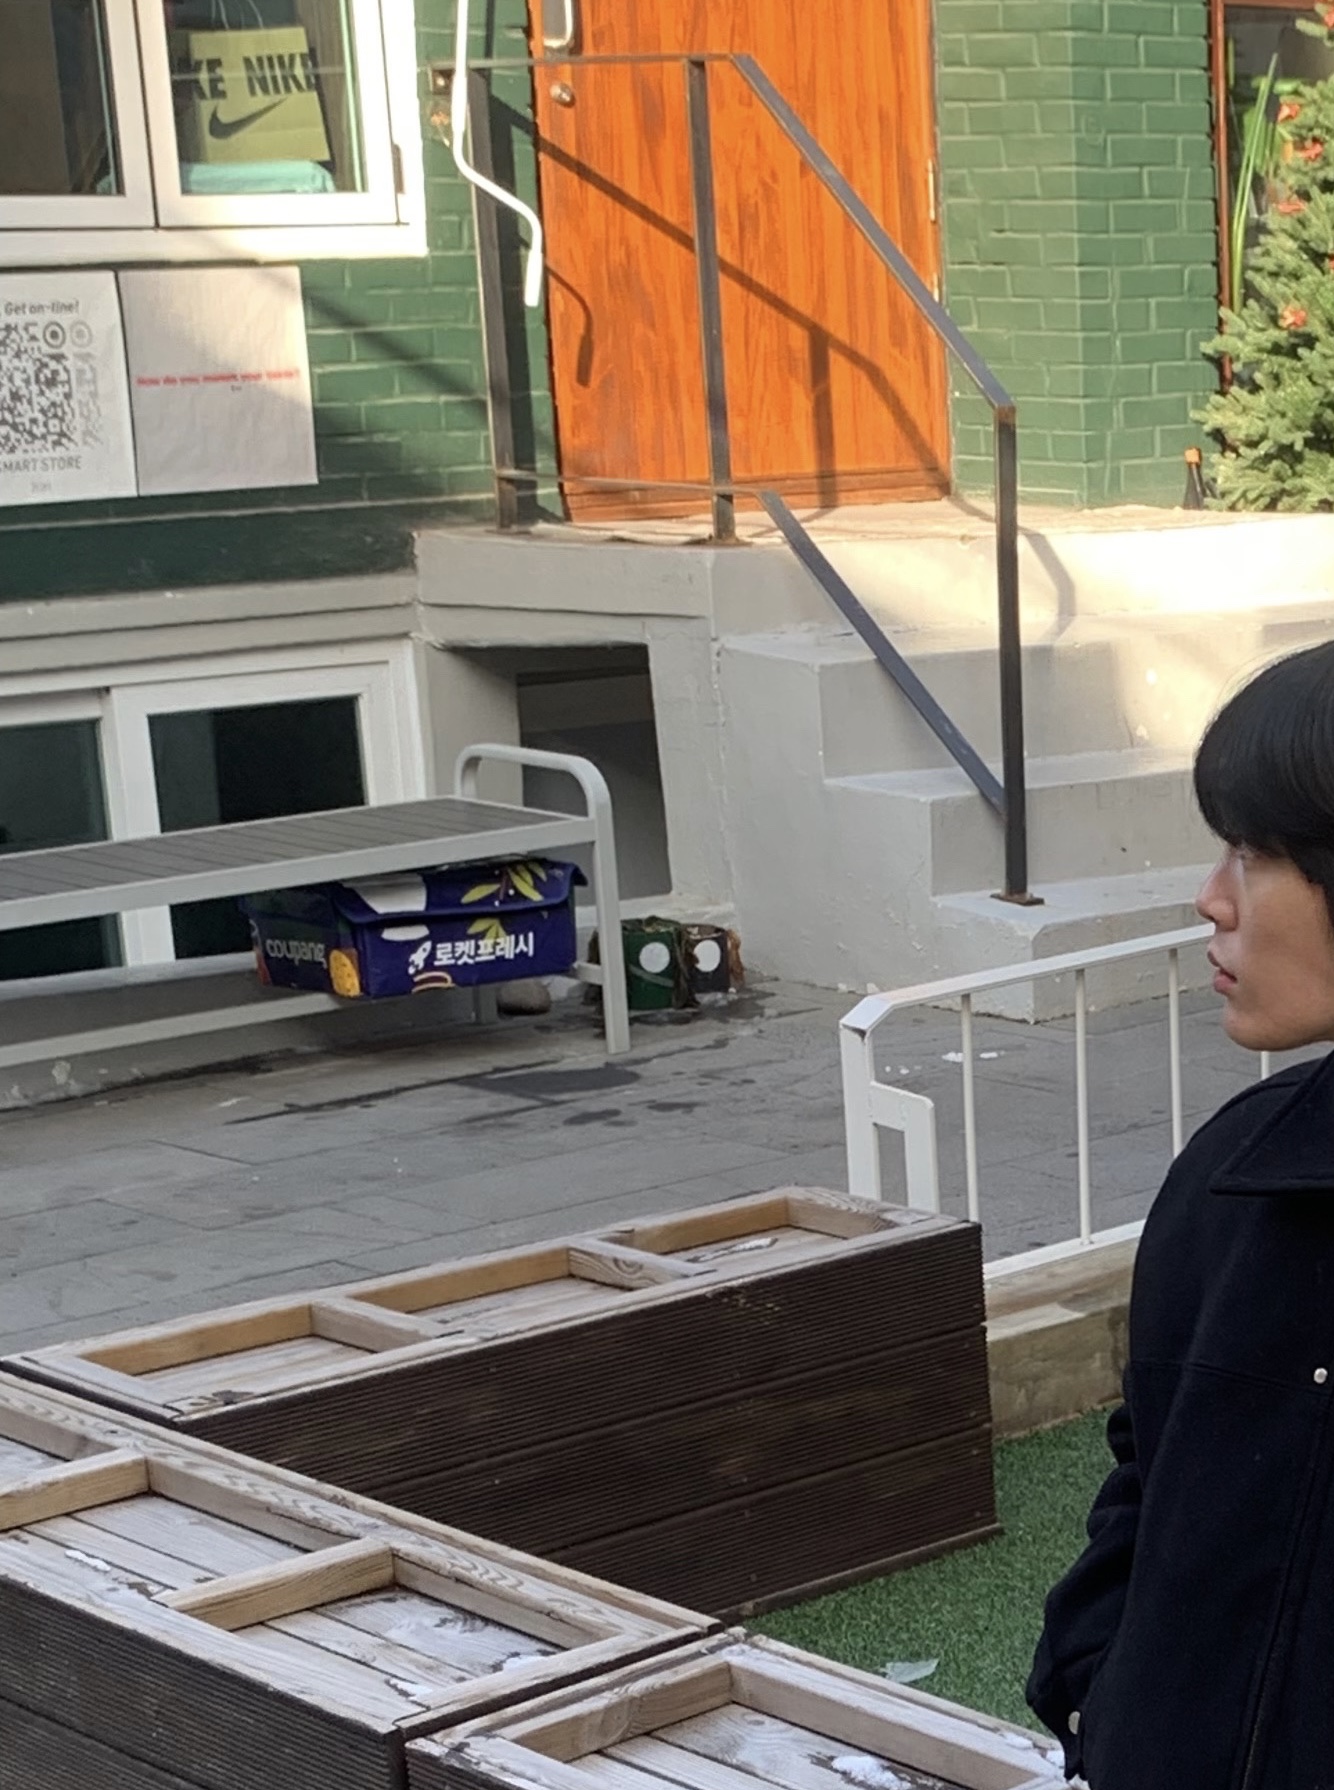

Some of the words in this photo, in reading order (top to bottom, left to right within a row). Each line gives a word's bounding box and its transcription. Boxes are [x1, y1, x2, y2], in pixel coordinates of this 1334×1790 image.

[242, 48, 320, 98] NIKE
[4, 301, 27, 316] Get
[40, 455, 82, 472] STORE
[265, 939, 327, 969] coupang
[433, 931, 534, 966] 로켓프레시
